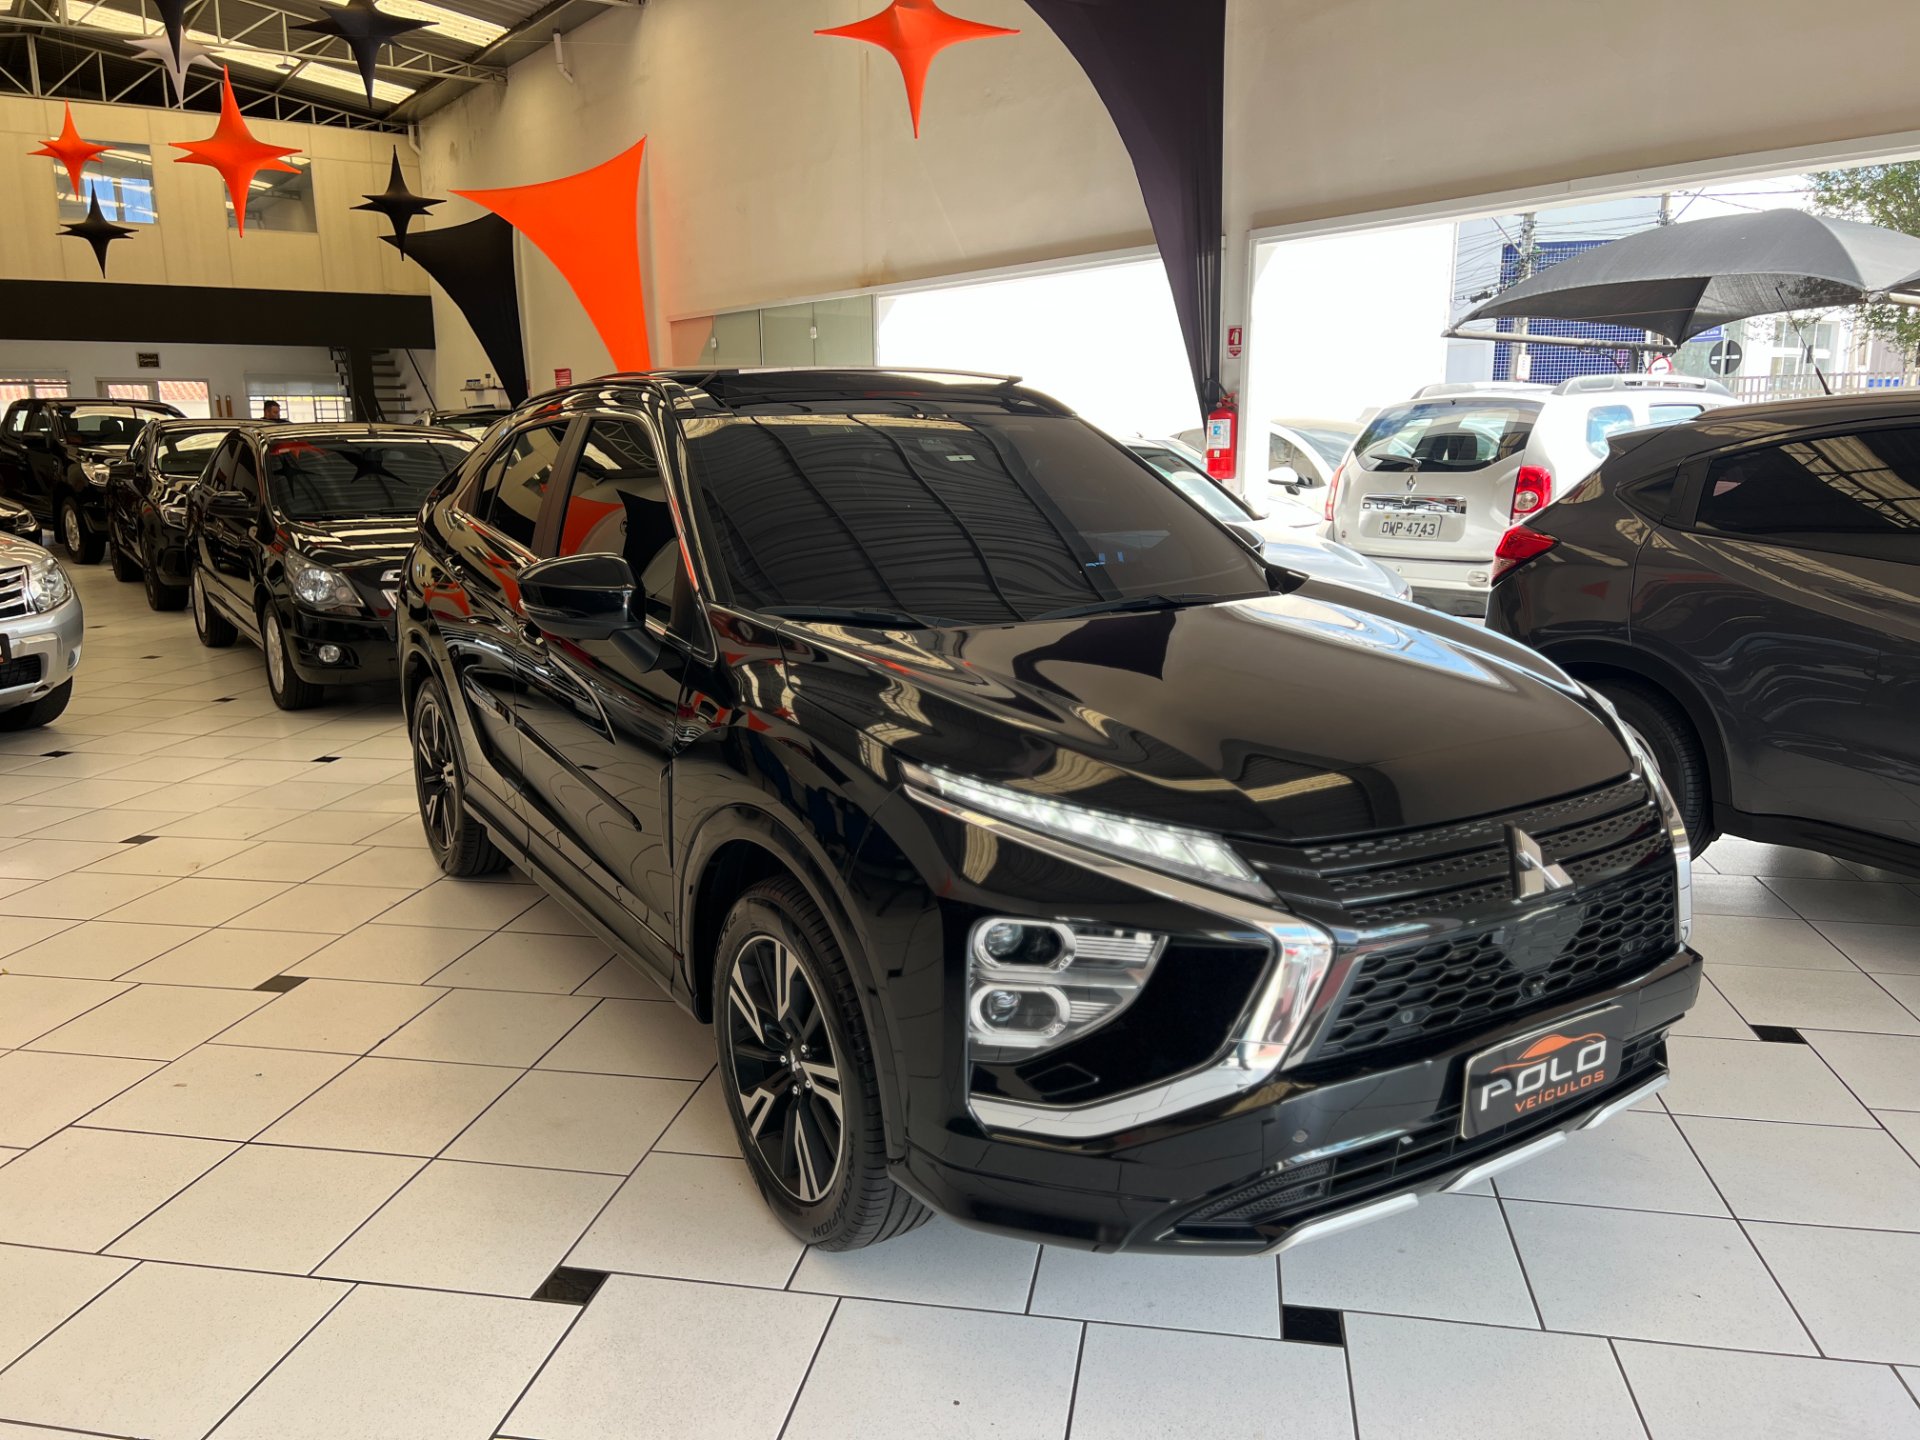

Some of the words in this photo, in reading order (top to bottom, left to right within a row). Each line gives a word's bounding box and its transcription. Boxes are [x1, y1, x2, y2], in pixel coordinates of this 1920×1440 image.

[1362, 502, 1457, 513] DUSTER
[1480, 1039, 1607, 1111] POLO
[1514, 1069, 1605, 1113] VEÍCULOS
